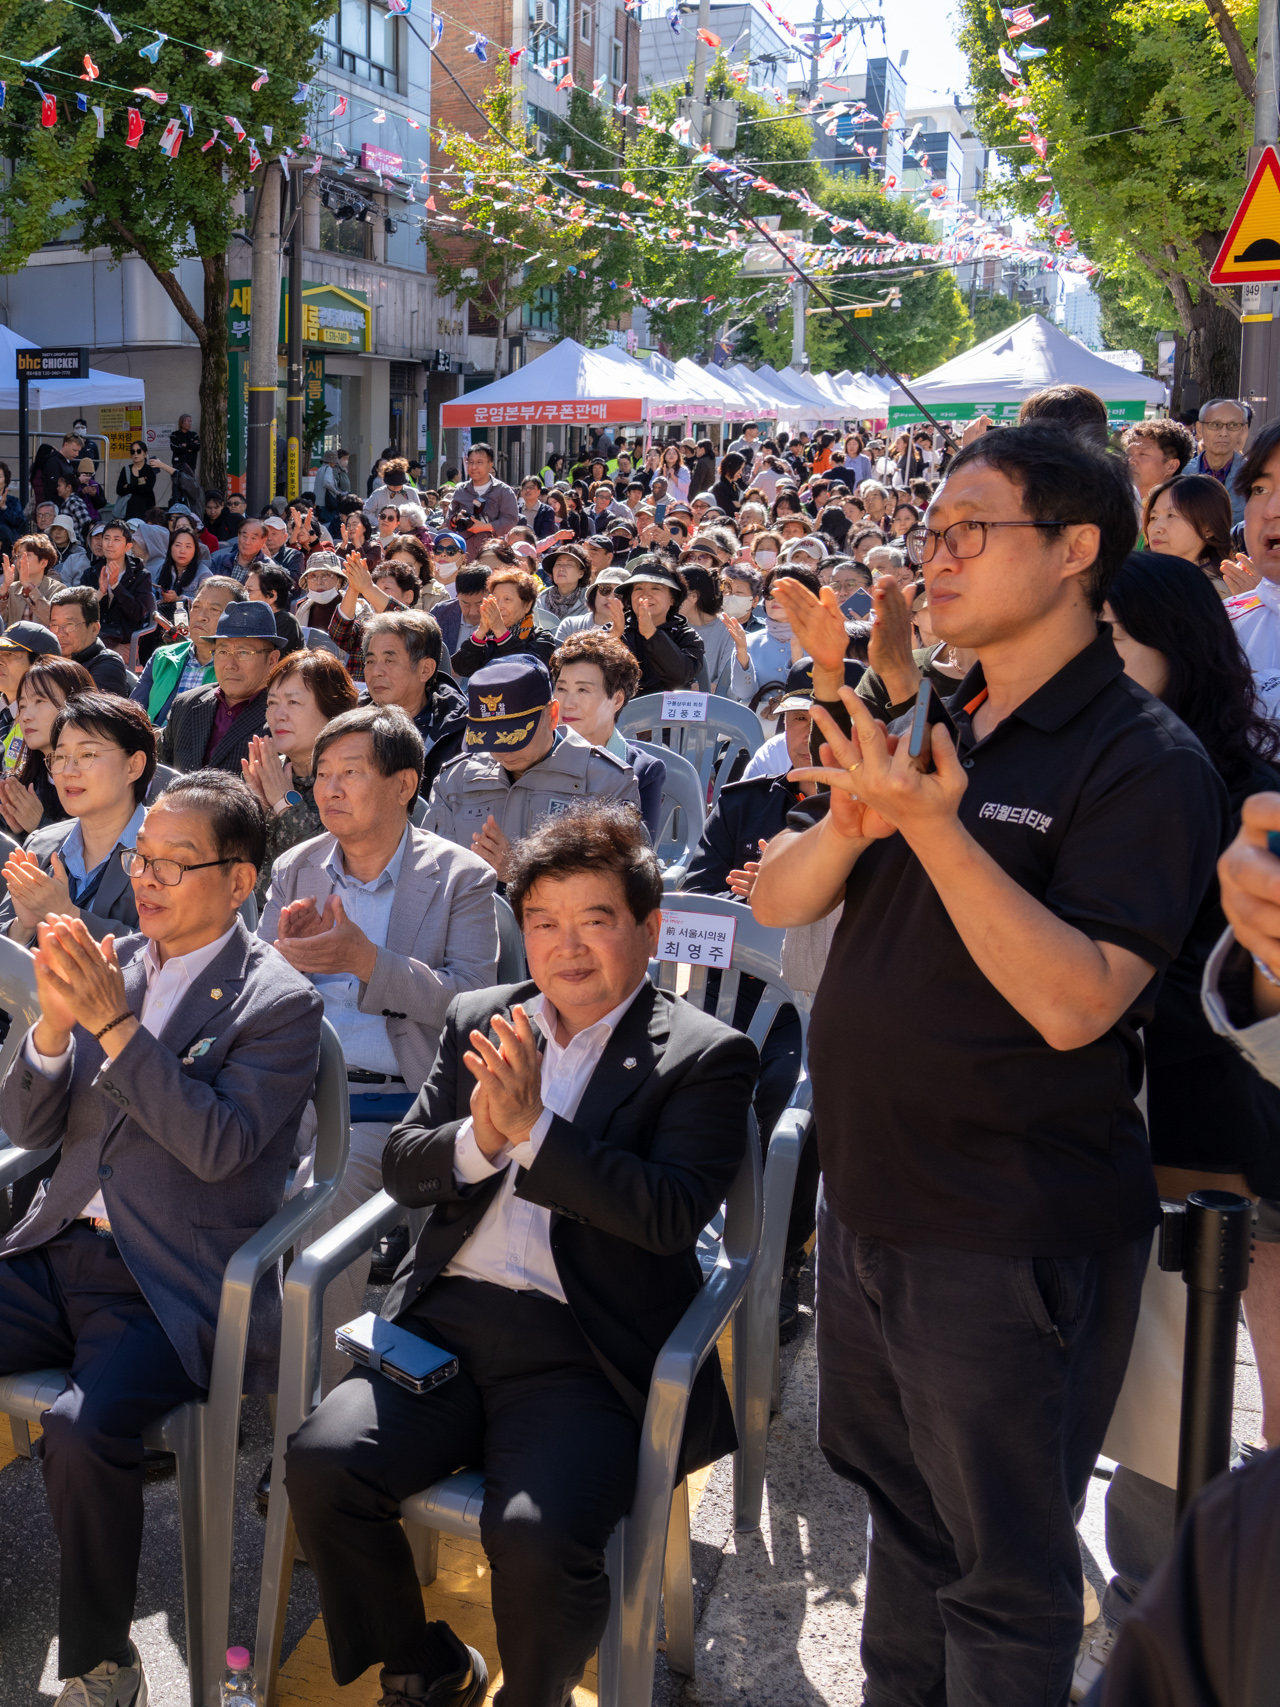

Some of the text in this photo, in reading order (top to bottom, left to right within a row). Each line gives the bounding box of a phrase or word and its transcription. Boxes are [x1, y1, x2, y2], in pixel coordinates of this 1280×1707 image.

[1245, 284, 1260, 297] 949
[18, 354, 79, 370] bhc CHICKEN
[307, 360, 324, 399] 새롬
[474, 403, 608, 423] 운영본부/쿠폰판매
[288, 452, 297, 498] 어린이보호구역
[679, 928, 726, 942] 서울시의원
